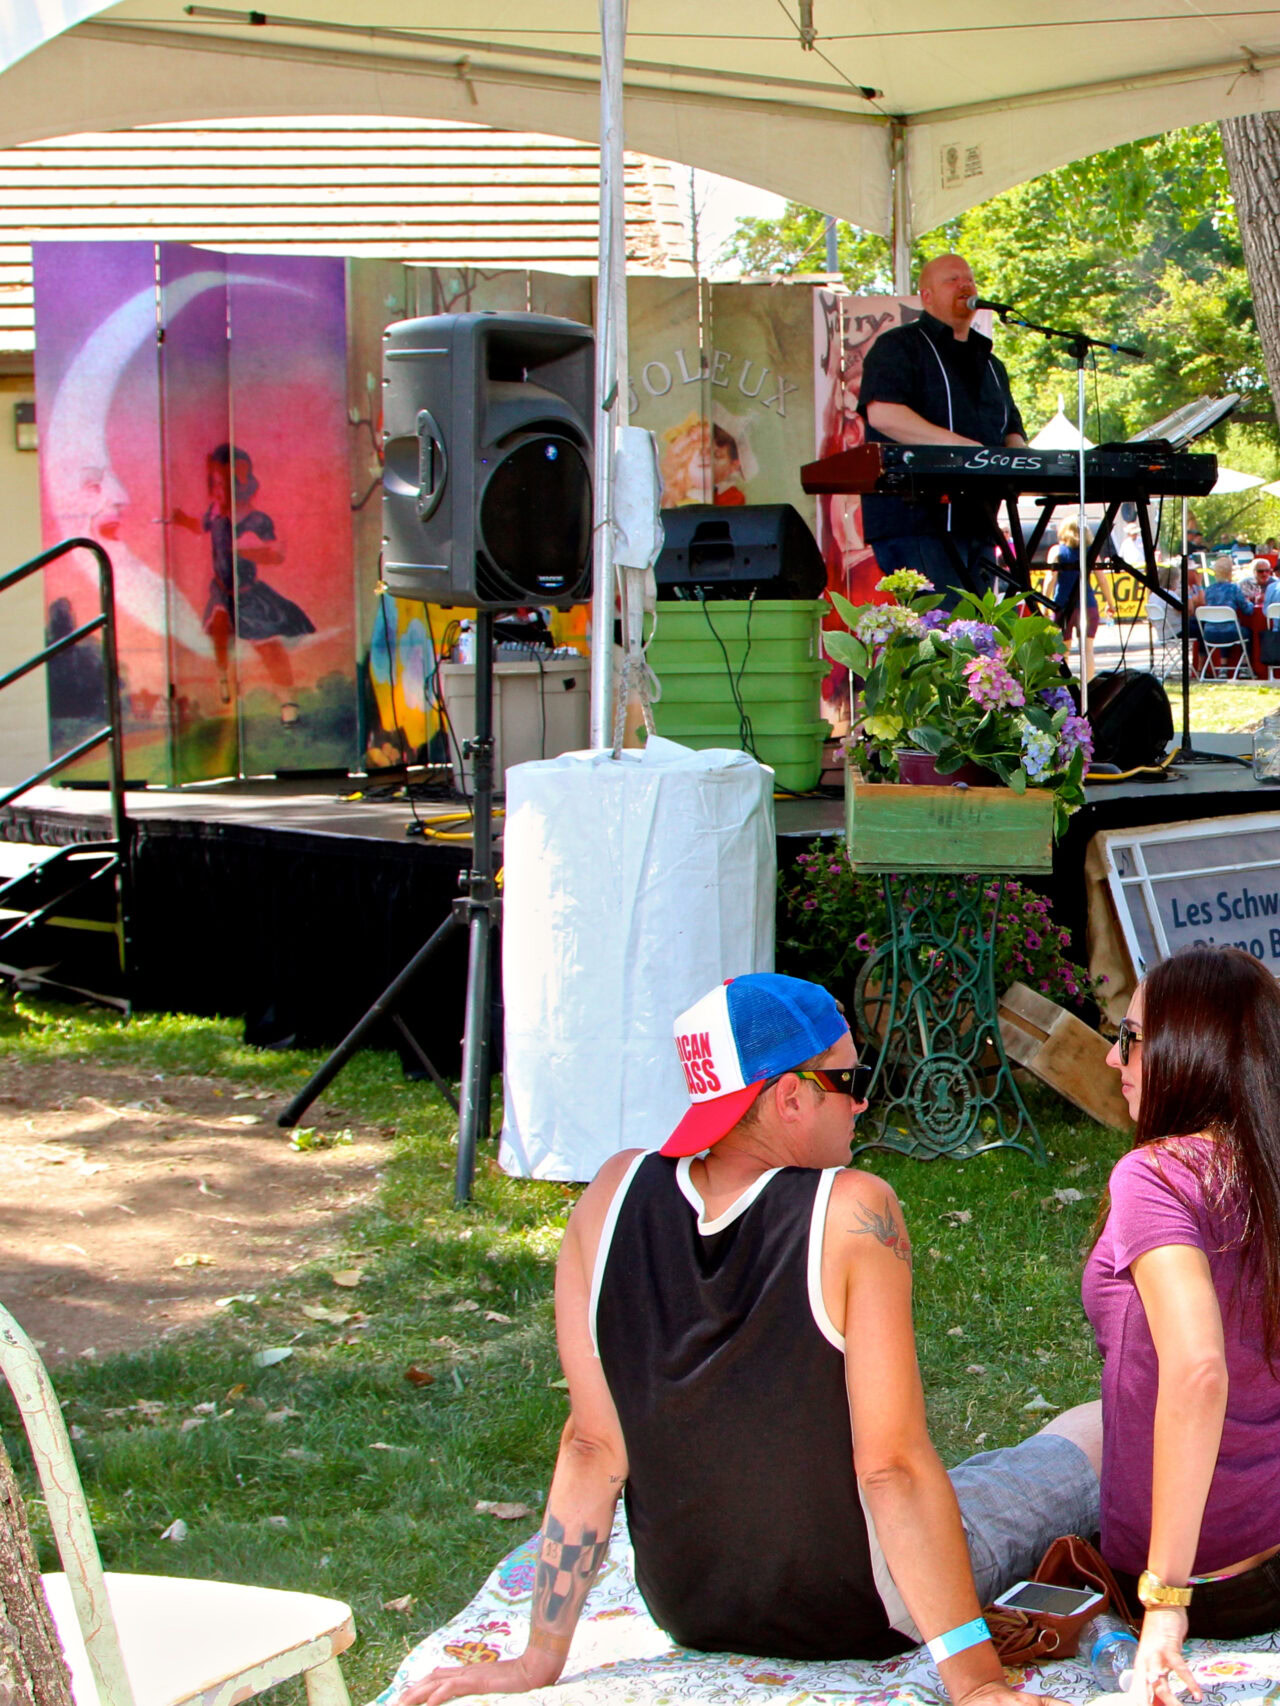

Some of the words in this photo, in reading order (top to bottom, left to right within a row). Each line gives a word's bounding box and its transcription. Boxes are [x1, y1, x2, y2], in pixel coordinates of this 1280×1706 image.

[1171, 898, 1213, 928] Les
[674, 1031, 712, 1062] ICAN
[681, 1058, 722, 1094] ASS
